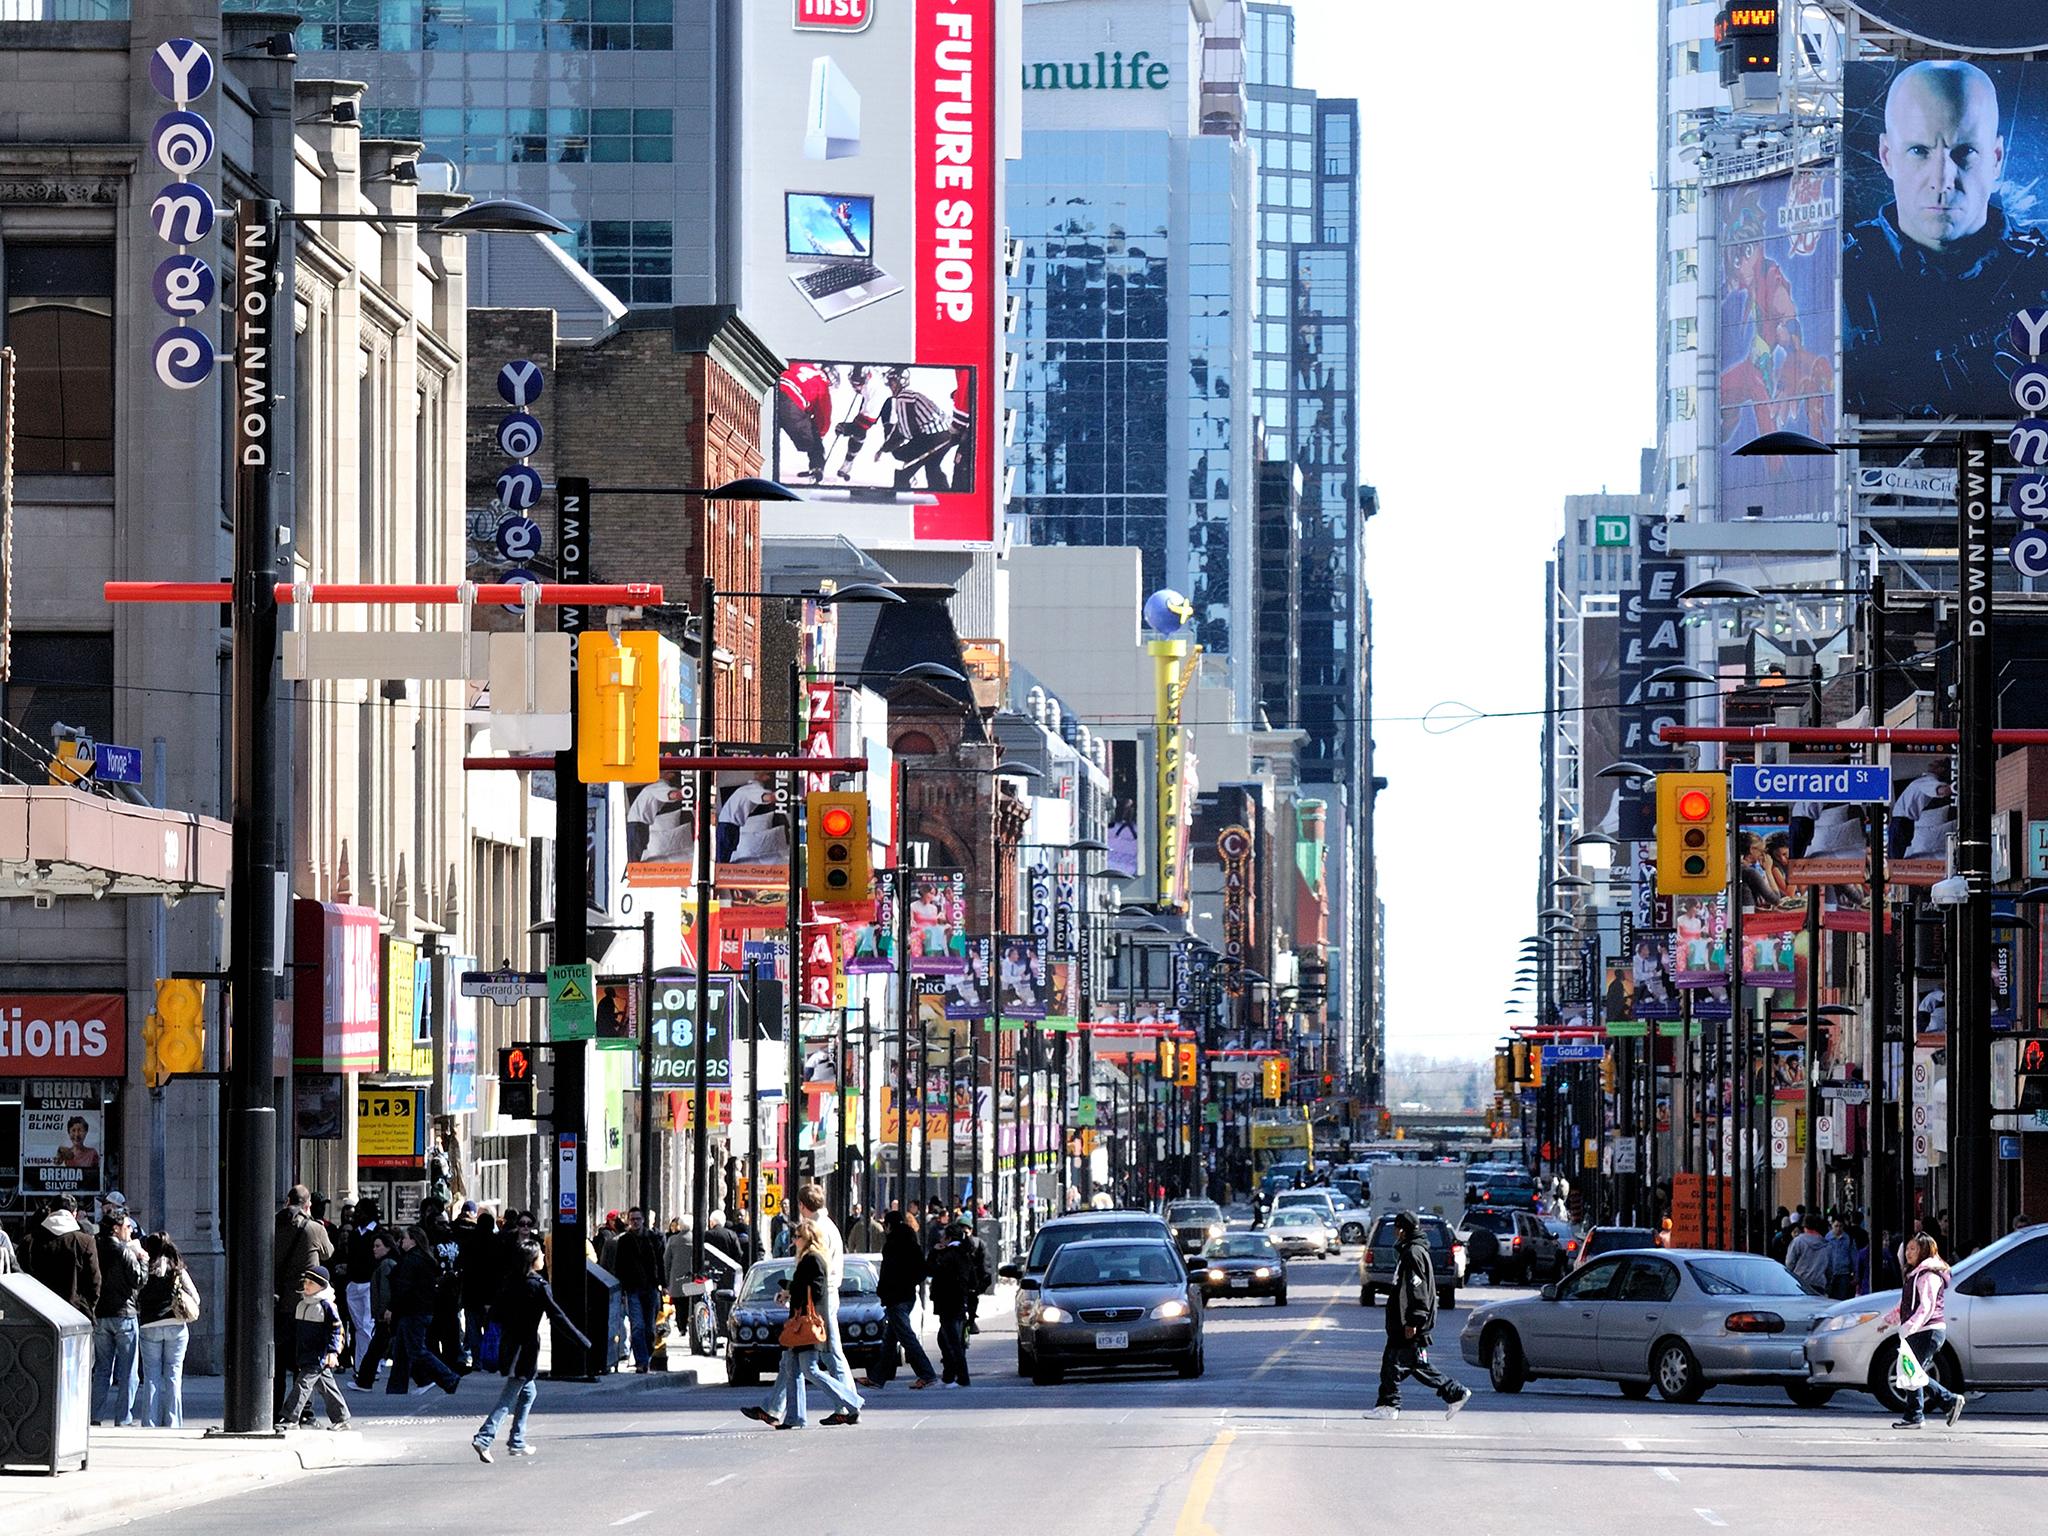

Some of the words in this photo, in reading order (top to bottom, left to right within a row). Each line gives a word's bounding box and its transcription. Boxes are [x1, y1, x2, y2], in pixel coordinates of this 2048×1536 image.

[1732, 9, 1774, 25] WW
[1022, 51, 1169, 90] nulife
[934, 13, 973, 190] FUTURE
[151, 38, 215, 390] Yonge
[1779, 203, 1833, 227] BAKUGAN
[934, 199, 973, 323] SHOP
[243, 224, 268, 466] DOWNTOWN
[1885, 473, 1951, 492] CLEARCH
[1599, 521, 1628, 541] TD
[1968, 449, 1986, 637] DOWNTOWN
[563, 495, 580, 671] WTOWN
[107, 748, 128, 779] Yonge
[679, 748, 694, 812] HOTES
[775, 751, 789, 814] HOTES
[1754, 768, 1849, 793] Gerrard
[1856, 770, 1869, 782] St
[808, 690, 833, 1004] ZANAR
[882, 873, 893, 937] SHOPPING
[953, 872, 964, 937] SHOPPING
[1057, 913, 1066, 952] TOWN
[553, 967, 588, 979] NOTICE
[980, 938, 990, 986] BUSINESS
[1037, 938, 1047, 987] BUSINESS
[1081, 929, 1089, 995] DOWNTOWN
[1668, 932, 1678, 983] BUSINESS
[1998, 947, 2008, 995] BUSINESS
[480, 984, 513, 995] Gerrard
[514, 984, 524, 995] St
[525, 984, 531, 995] E
[918, 982, 946, 994] GRO
[628, 977, 638, 1039] ENTERTAINMENT
[0, 1007, 108, 1057] tions
[652, 1018, 717, 1047] 18+
[1558, 1047, 1584, 1056] Gould
[33, 1081, 93, 1099] BRENDA
[41, 1099, 84, 1110] SILVER
[1836, 1088, 1863, 1098] Walton
[28, 1113, 64, 1122] BLING!
[28, 1122, 64, 1131] BLING!
[39, 1168, 84, 1182] BRENDA
[44, 1181, 78, 1190] SILVER
